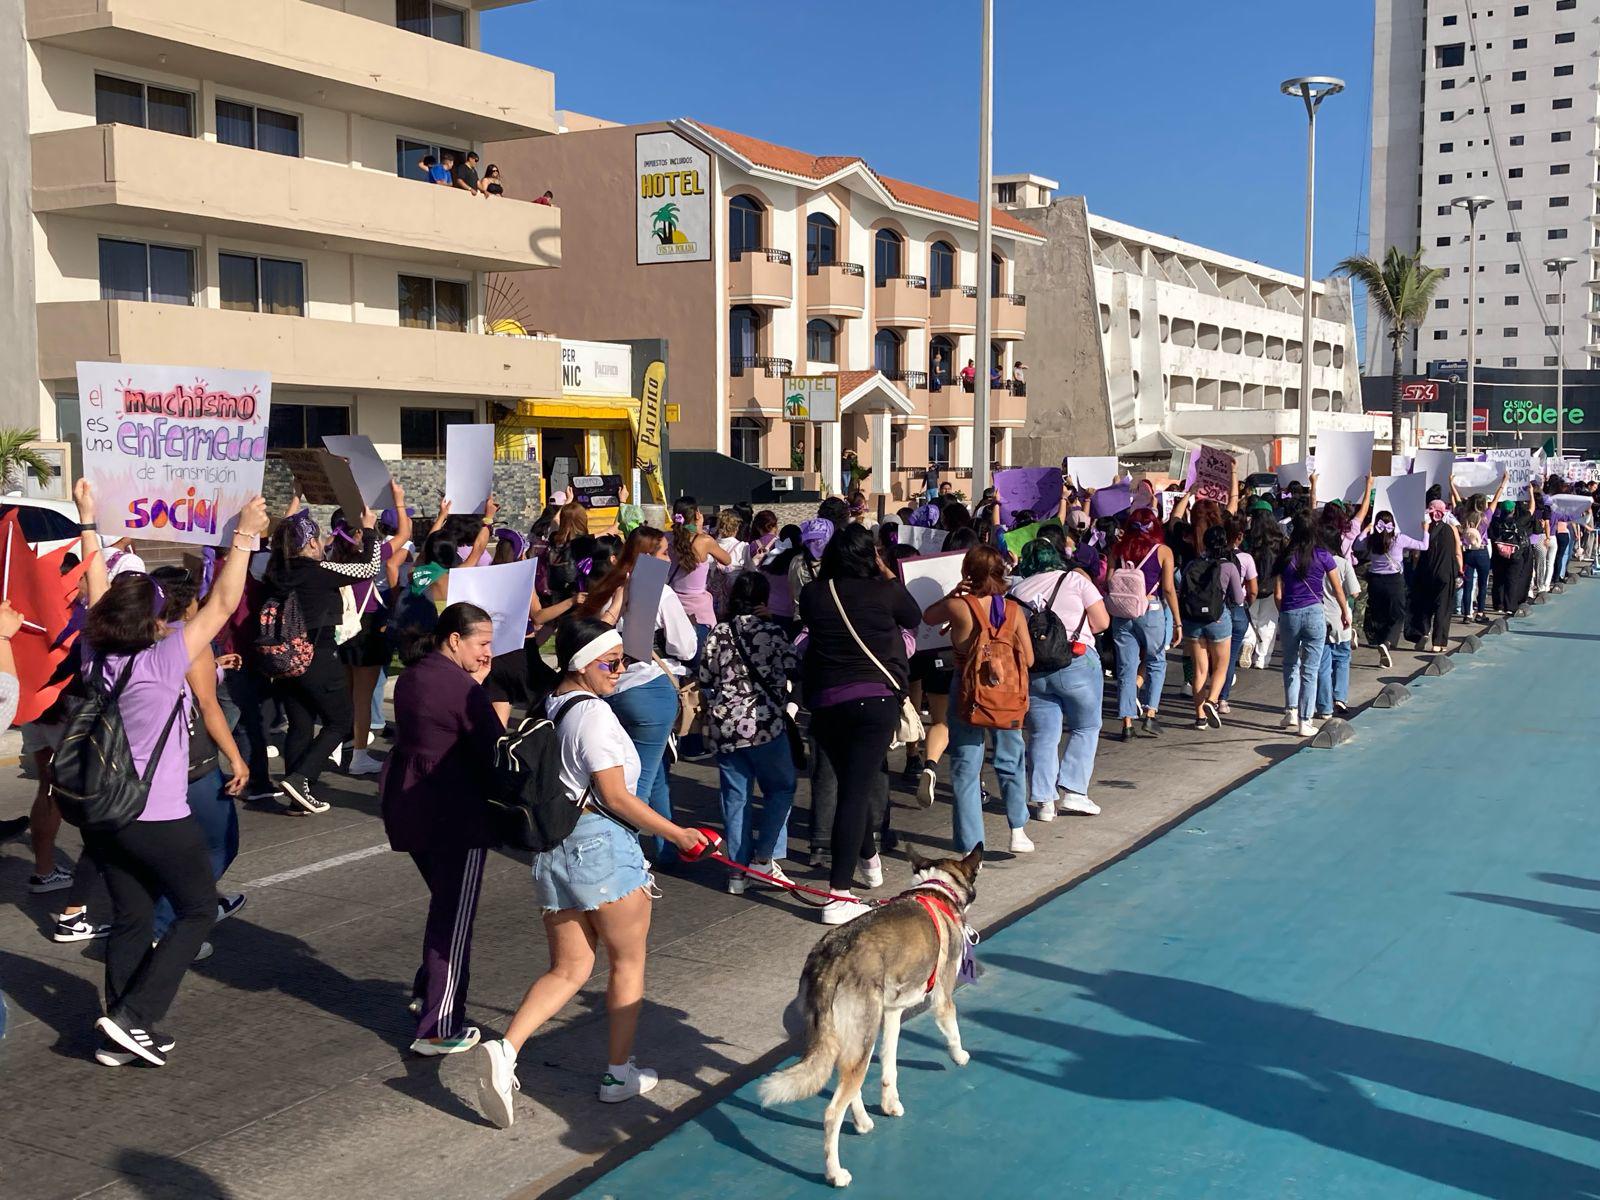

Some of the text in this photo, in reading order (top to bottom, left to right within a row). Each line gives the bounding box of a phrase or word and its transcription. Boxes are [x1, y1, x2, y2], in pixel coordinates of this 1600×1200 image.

[641, 170, 705, 199] HOTEL
[562, 348, 576, 363] PER
[562, 365, 582, 387] NIC
[789, 376, 832, 391] HOTEL
[88, 384, 256, 420] el machismo
[1503, 400, 1533, 409] CASINO
[641, 377, 659, 448] PACIFICO
[86, 417, 109, 433] es
[86, 437, 113, 452] una
[136, 462, 156, 480] de
[1199, 484, 1227, 504] SOLA
[125, 486, 224, 535] social
